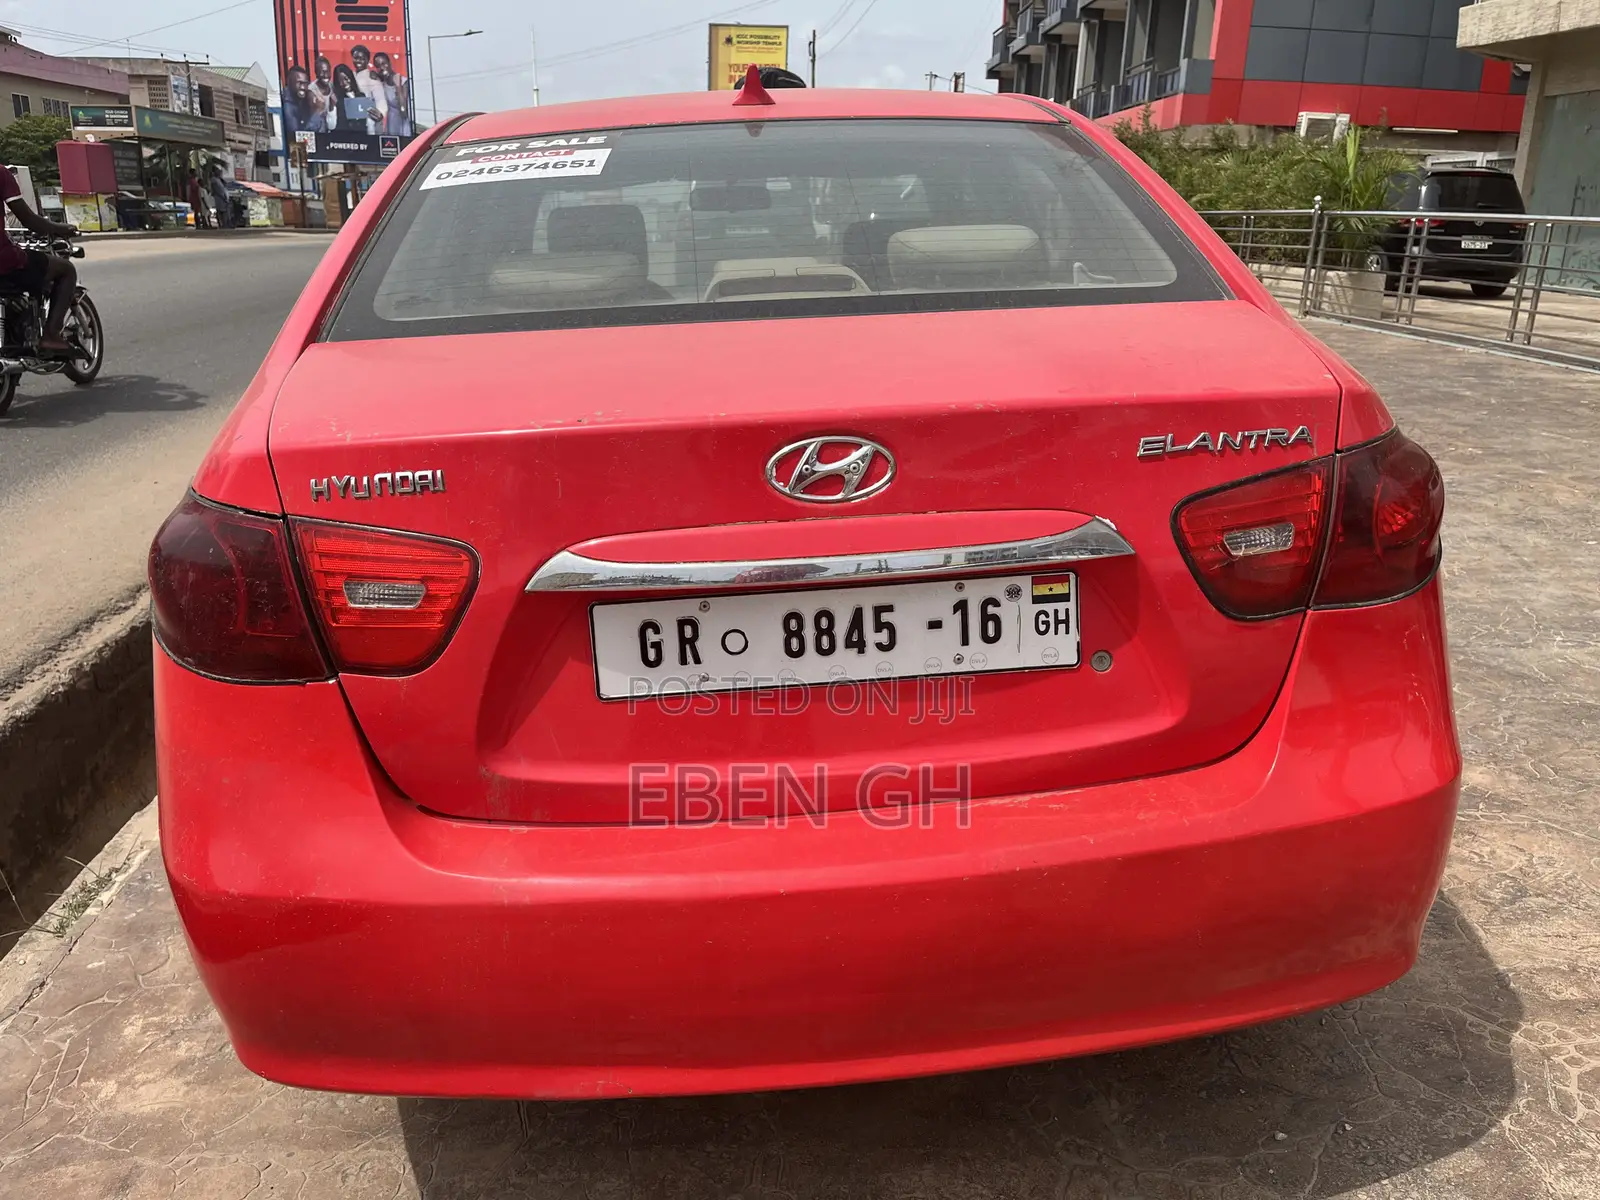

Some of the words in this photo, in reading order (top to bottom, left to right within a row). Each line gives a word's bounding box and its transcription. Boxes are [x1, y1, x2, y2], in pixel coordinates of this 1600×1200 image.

[320, 30, 355, 41] LEARN
[329, 142, 359, 150] POWERED
[360, 143, 368, 151] BY
[456, 142, 520, 157] FOR
[526, 135, 608, 149] SALE
[477, 149, 570, 163] CONTACT
[435, 159, 596, 181] 0246374651
[1137, 425, 1313, 457] ELANTRA
[310, 469, 445, 502] HYUNDAI
[1034, 606, 1071, 638] GH
[637, 615, 702, 668] GR
[782, 603, 897, 660] 8845
